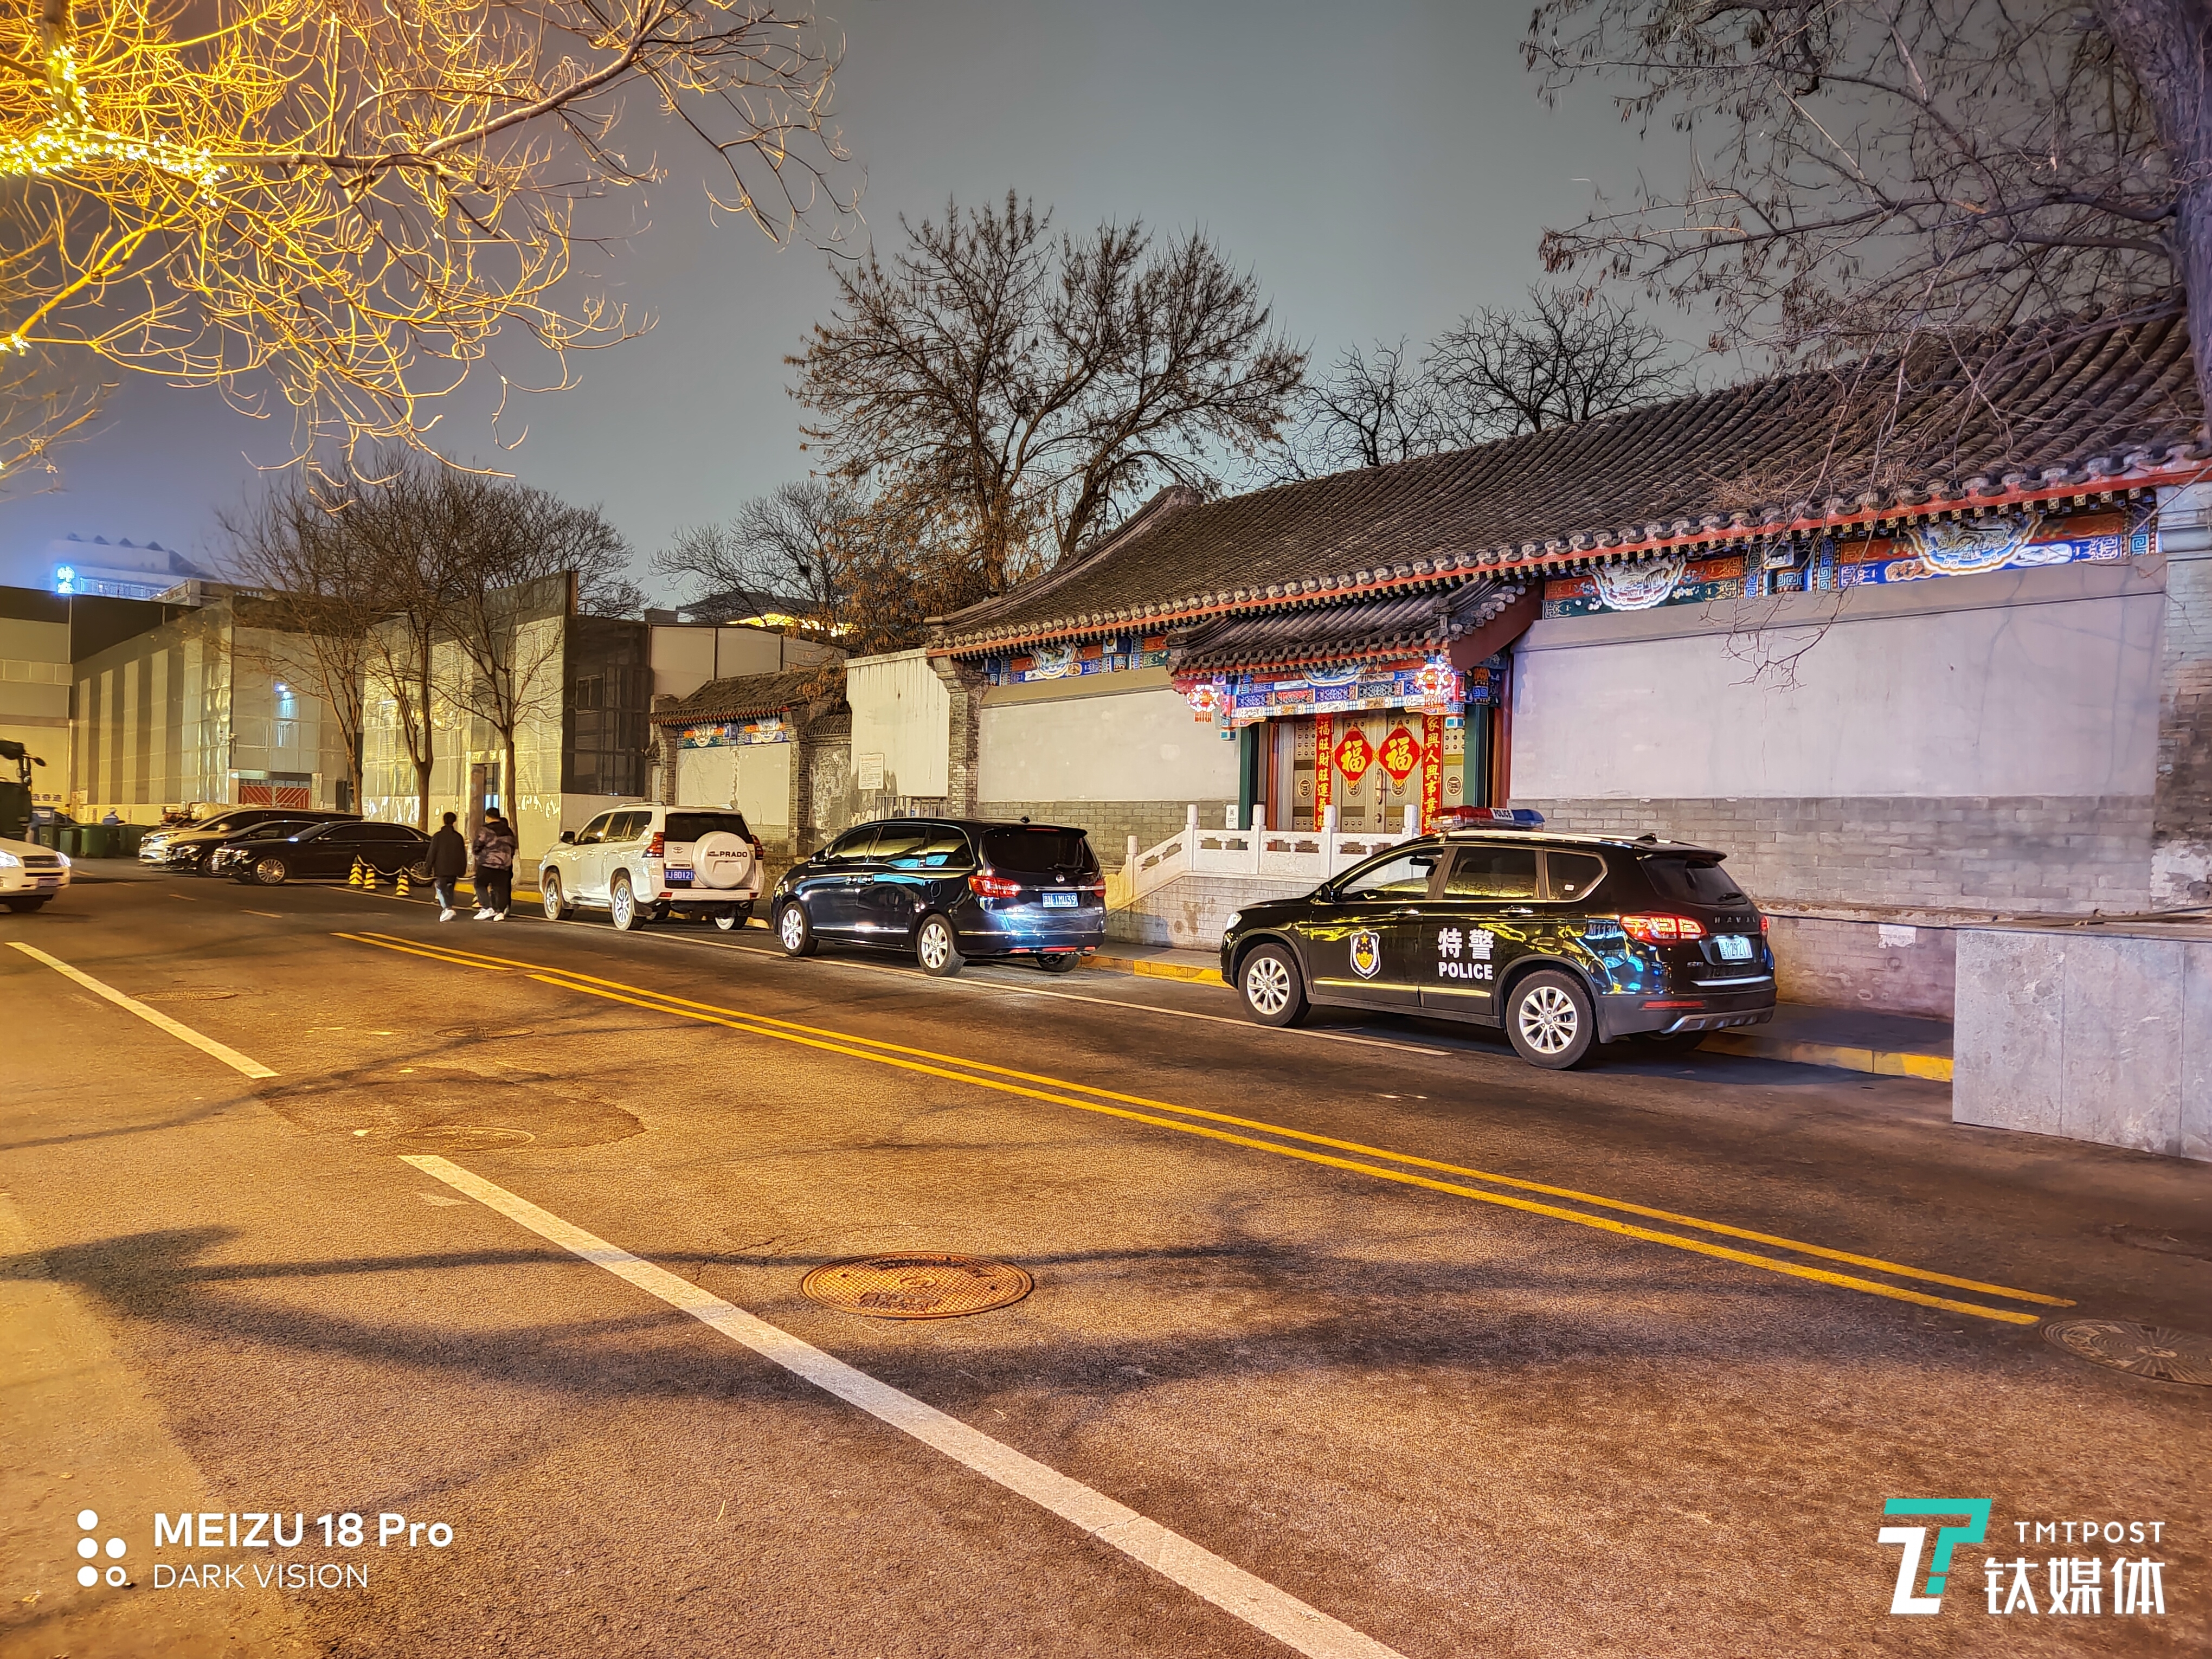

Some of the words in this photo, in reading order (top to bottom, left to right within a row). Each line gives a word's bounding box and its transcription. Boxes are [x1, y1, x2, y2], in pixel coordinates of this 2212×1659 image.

[1340, 739, 1366, 773] 福
[1385, 736, 1413, 771] 福
[1493, 808, 1512, 819] POLICE
[1589, 924, 1617, 935] M1130
[1438, 928, 1494, 960] 特警
[1438, 962, 1493, 980] POLICE
